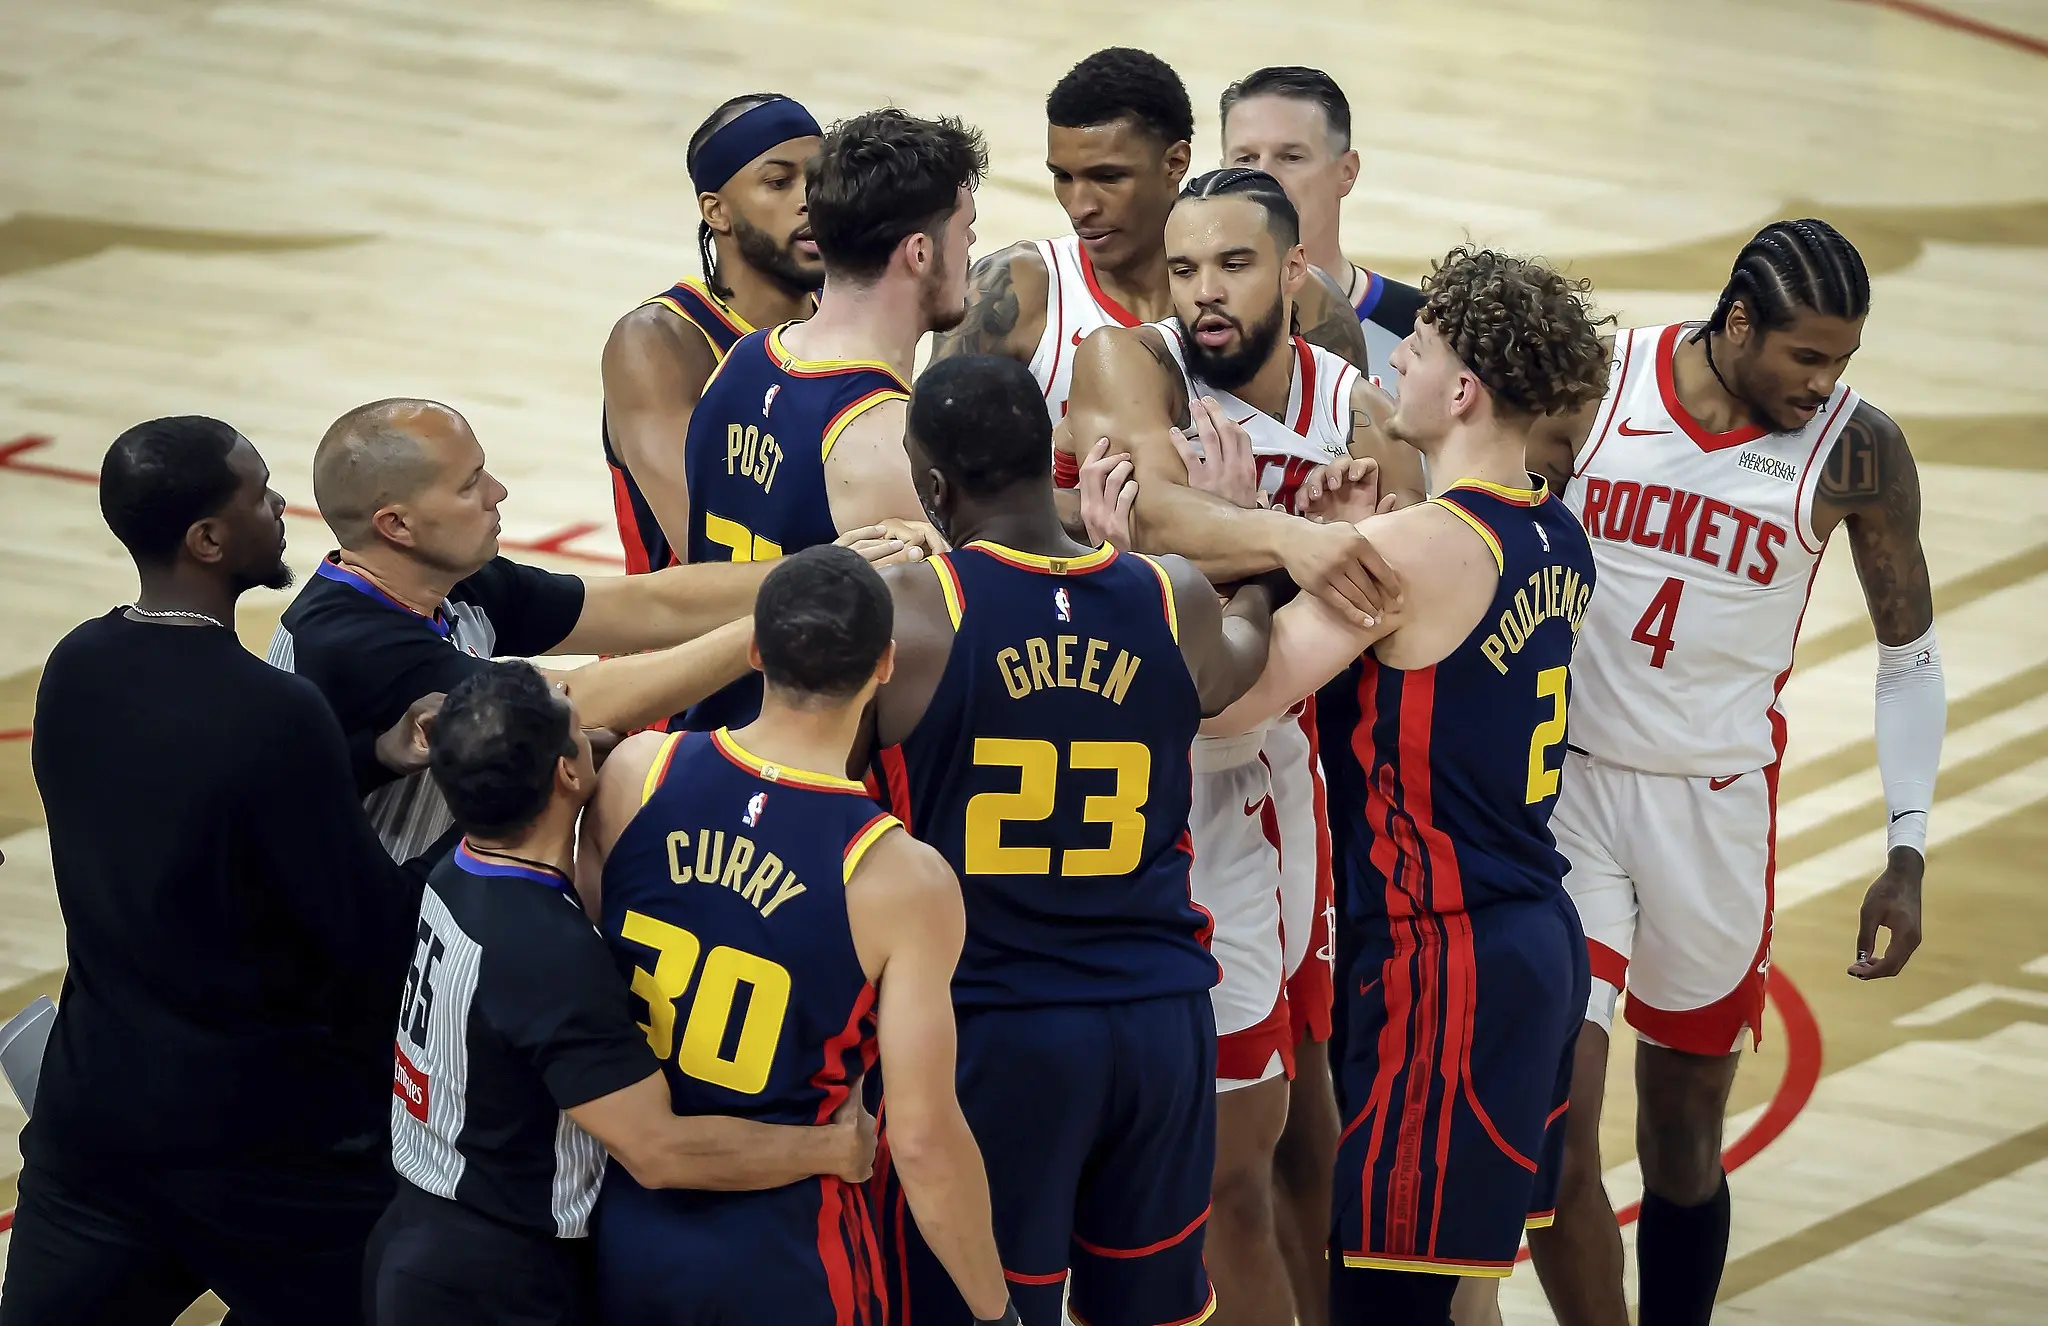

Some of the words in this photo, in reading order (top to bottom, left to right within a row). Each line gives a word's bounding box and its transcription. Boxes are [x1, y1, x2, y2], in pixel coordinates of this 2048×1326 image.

[727, 423, 784, 494] POST
[1738, 459, 1797, 482] HERMANN
[1740, 450, 1797, 475] MEMORIAL
[1582, 476, 1788, 587] ROCKETS
[1480, 565, 1590, 675] PODZIEMS
[1630, 576, 1686, 669] 4
[996, 634, 1142, 706] GREEN
[1525, 665, 1568, 805] 2
[965, 737, 1151, 877] 23
[666, 828, 808, 918] CURRY
[620, 909, 792, 1095] 30
